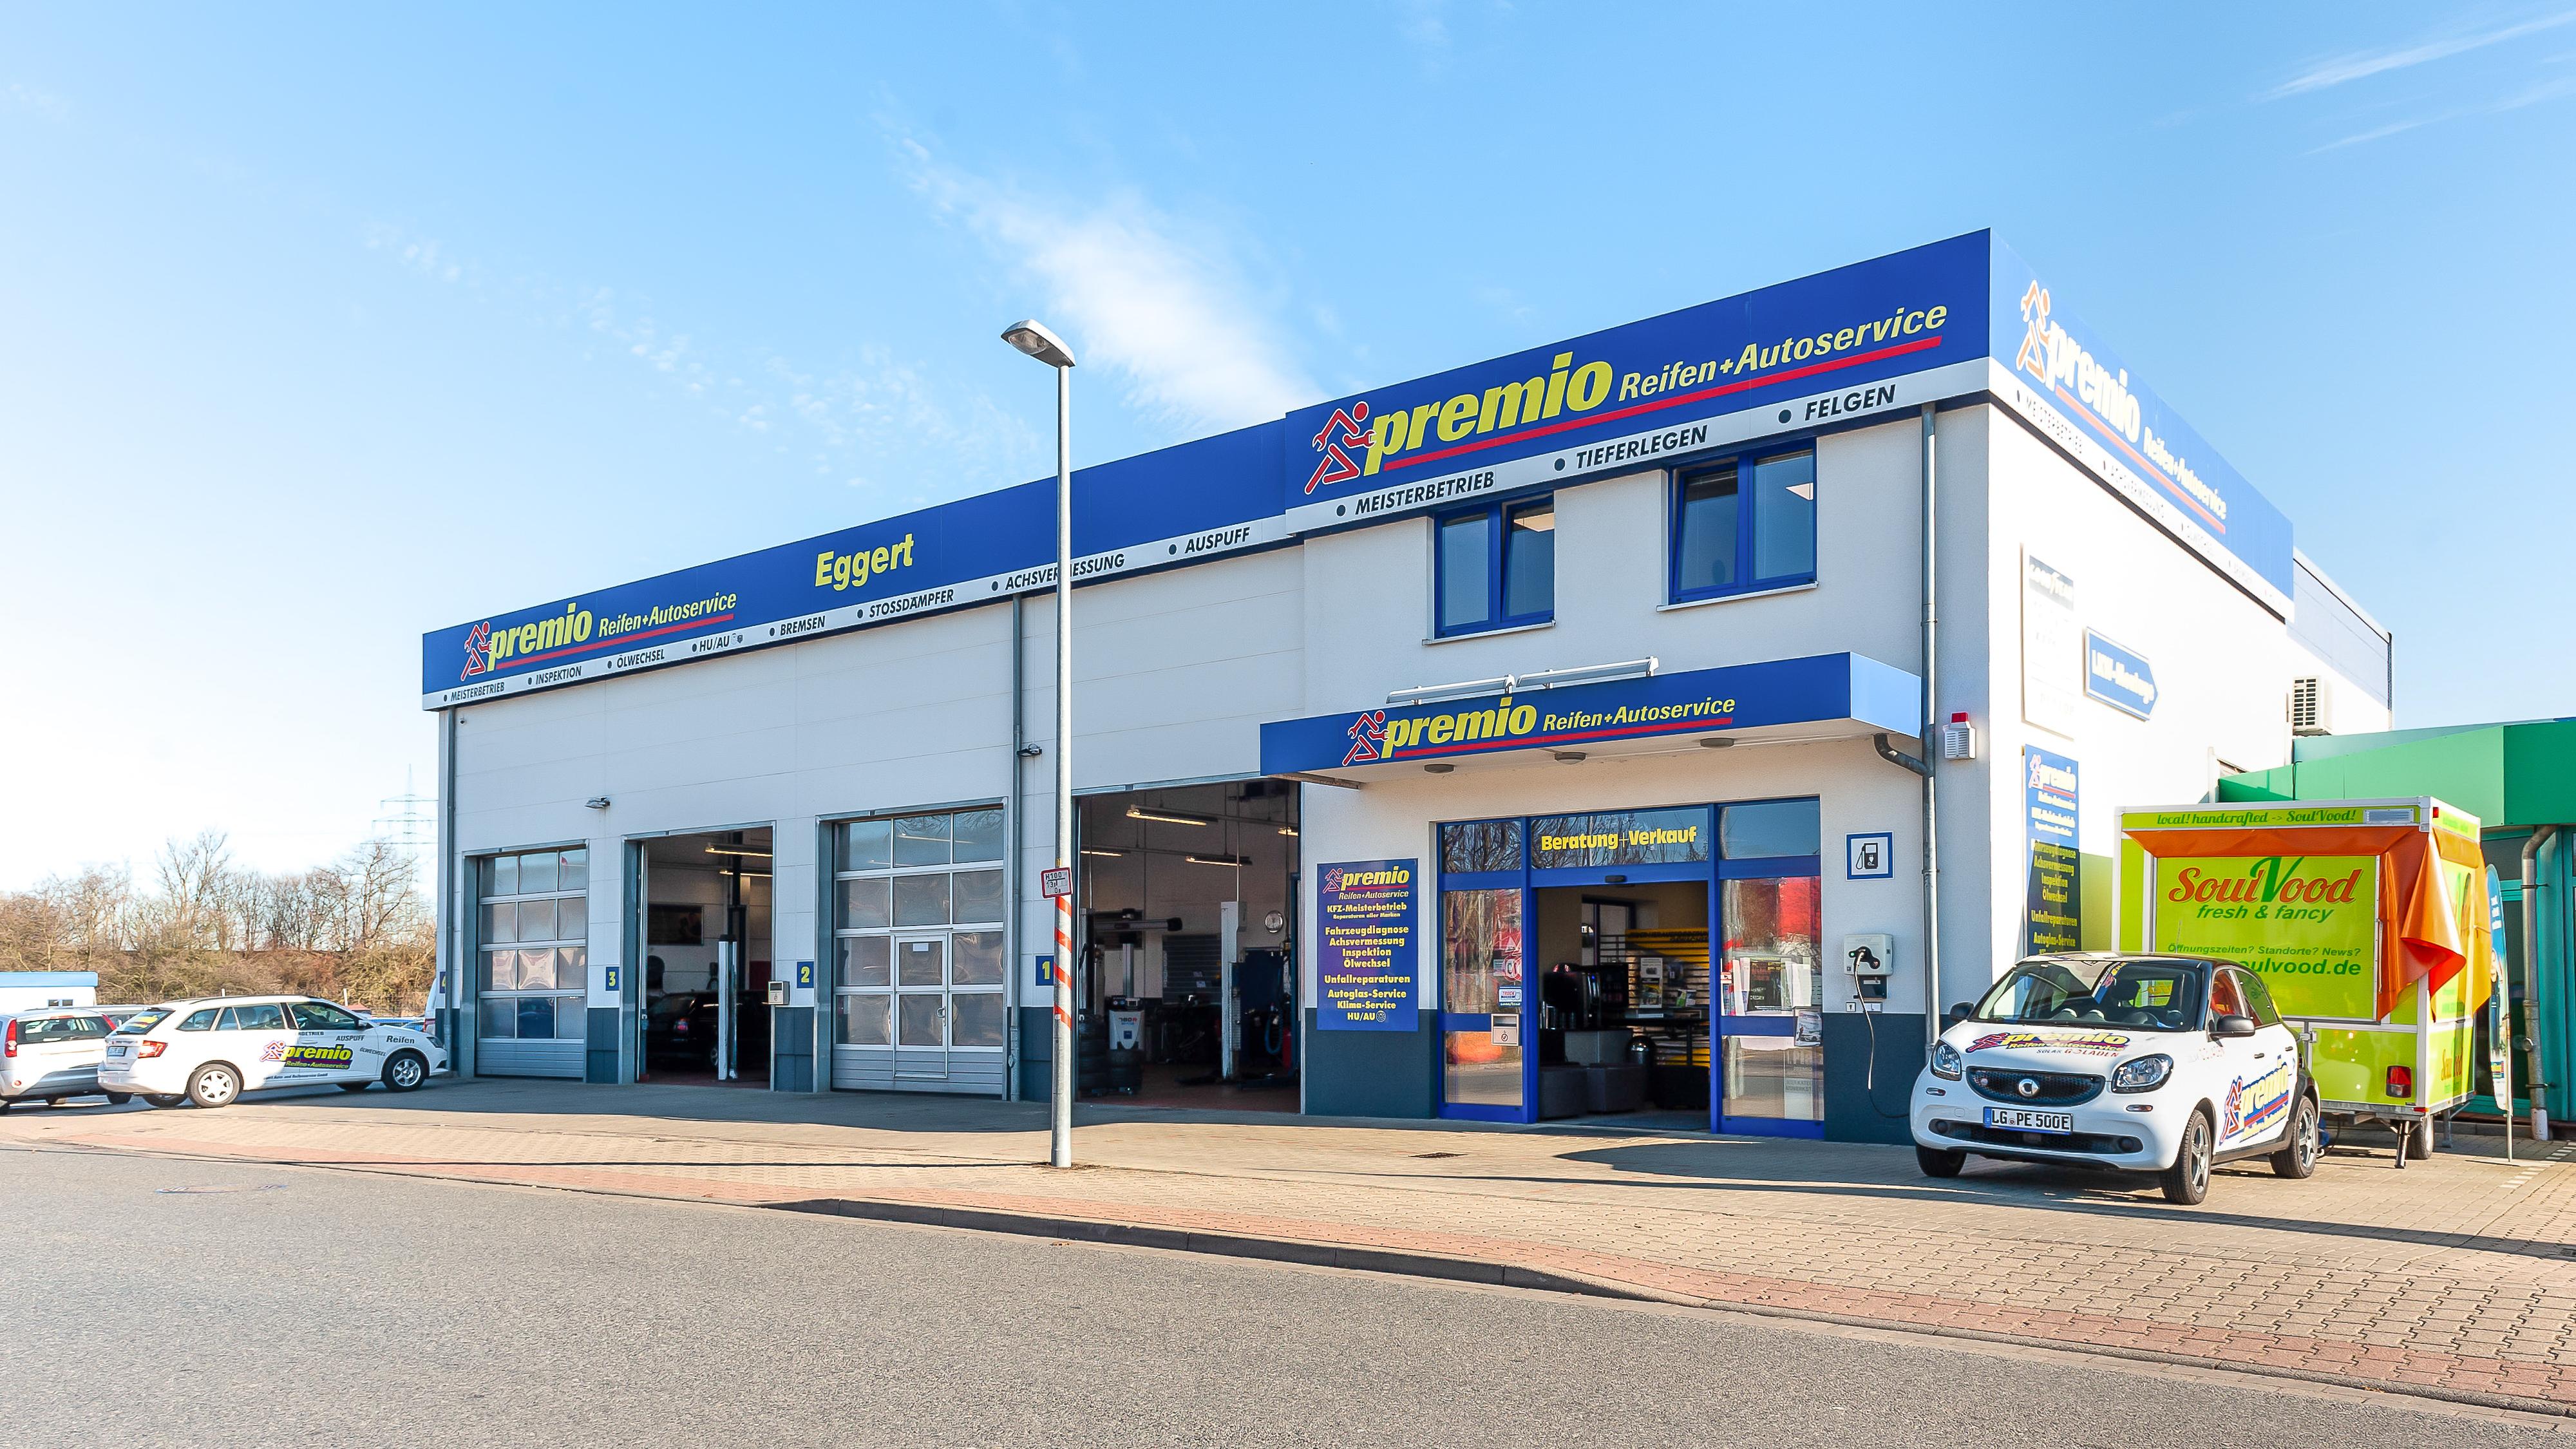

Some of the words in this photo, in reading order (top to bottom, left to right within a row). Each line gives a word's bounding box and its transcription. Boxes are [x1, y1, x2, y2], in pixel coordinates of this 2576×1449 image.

[2045, 320, 2140, 444] premio
[1363, 351, 1613, 477] premio
[1618, 305, 1947, 402] Reifen+Autoservice
[1355, 471, 1494, 515] MEISTERBETRIEB
[1577, 425, 1708, 469] TIEFERLEGEN
[1804, 384, 1896, 421] FELGEN
[815, 533, 914, 592] Eggert
[451, 682, 505, 701] MEISTERBETRIEB
[536, 666, 582, 685] INSPEKTION
[617, 649, 665, 669] ÖLWECHSEL
[699, 638, 730, 652] HU/AU
[779, 615, 826, 637] BREMSEN
[869, 589, 954, 618] STOSSDÄMPFER
[1005, 553, 1125, 591] ACHSVERESSUNG
[1185, 526, 1251, 555] AUSPUFF
[487, 602, 592, 672] premio
[598, 592, 737, 638] Reifen+Autoservice
[1381, 697, 1536, 759] premio
[1543, 697, 1735, 731] Reifen+Autoservice
[2157, 813, 2190, 824] local!
[2192, 811, 2268, 826] handcrafted
[1341, 866, 1409, 891] premio
[1339, 890, 1409, 900] Reifen+Autoservice
[1327, 902, 1407, 913] KFZ-Meisterbetrieb
[2197, 905, 2251, 920] fresh
[2255, 905, 2268, 919] &
[2276, 905, 2334, 923] fancy
[1325, 925, 1408, 936] Fahrzeugdiagnose
[1329, 937, 1405, 947] Achsvermessung
[2168, 943, 2254, 954] Öffnungszeiten?
[2258, 946, 2318, 956] Standorte?
[2322, 947, 2361, 956] News?
[1342, 947, 1391, 957] Inspektion
[1343, 956, 1390, 967] Ölwechsel
[800, 966, 810, 983] 2
[1042, 961, 1050, 980] 1
[609, 971, 616, 987] 3
[1324, 974, 1410, 985] Unfallreparaturen
[1327, 989, 1406, 999] Autoglas-Service
[1337, 1000, 1396, 1009] Klima-Service
[1347, 1011, 1376, 1021] HU/AU
[386, 1035, 415, 1043] Reifen
[2002, 1032, 2129, 1045] premio
[281, 1045, 352, 1061] premio
[2239, 1059, 2288, 1127] premio
[1992, 1110, 2007, 1124] LG
[2016, 1113, 2032, 1126] PE
[2036, 1114, 2070, 1130] 500E
